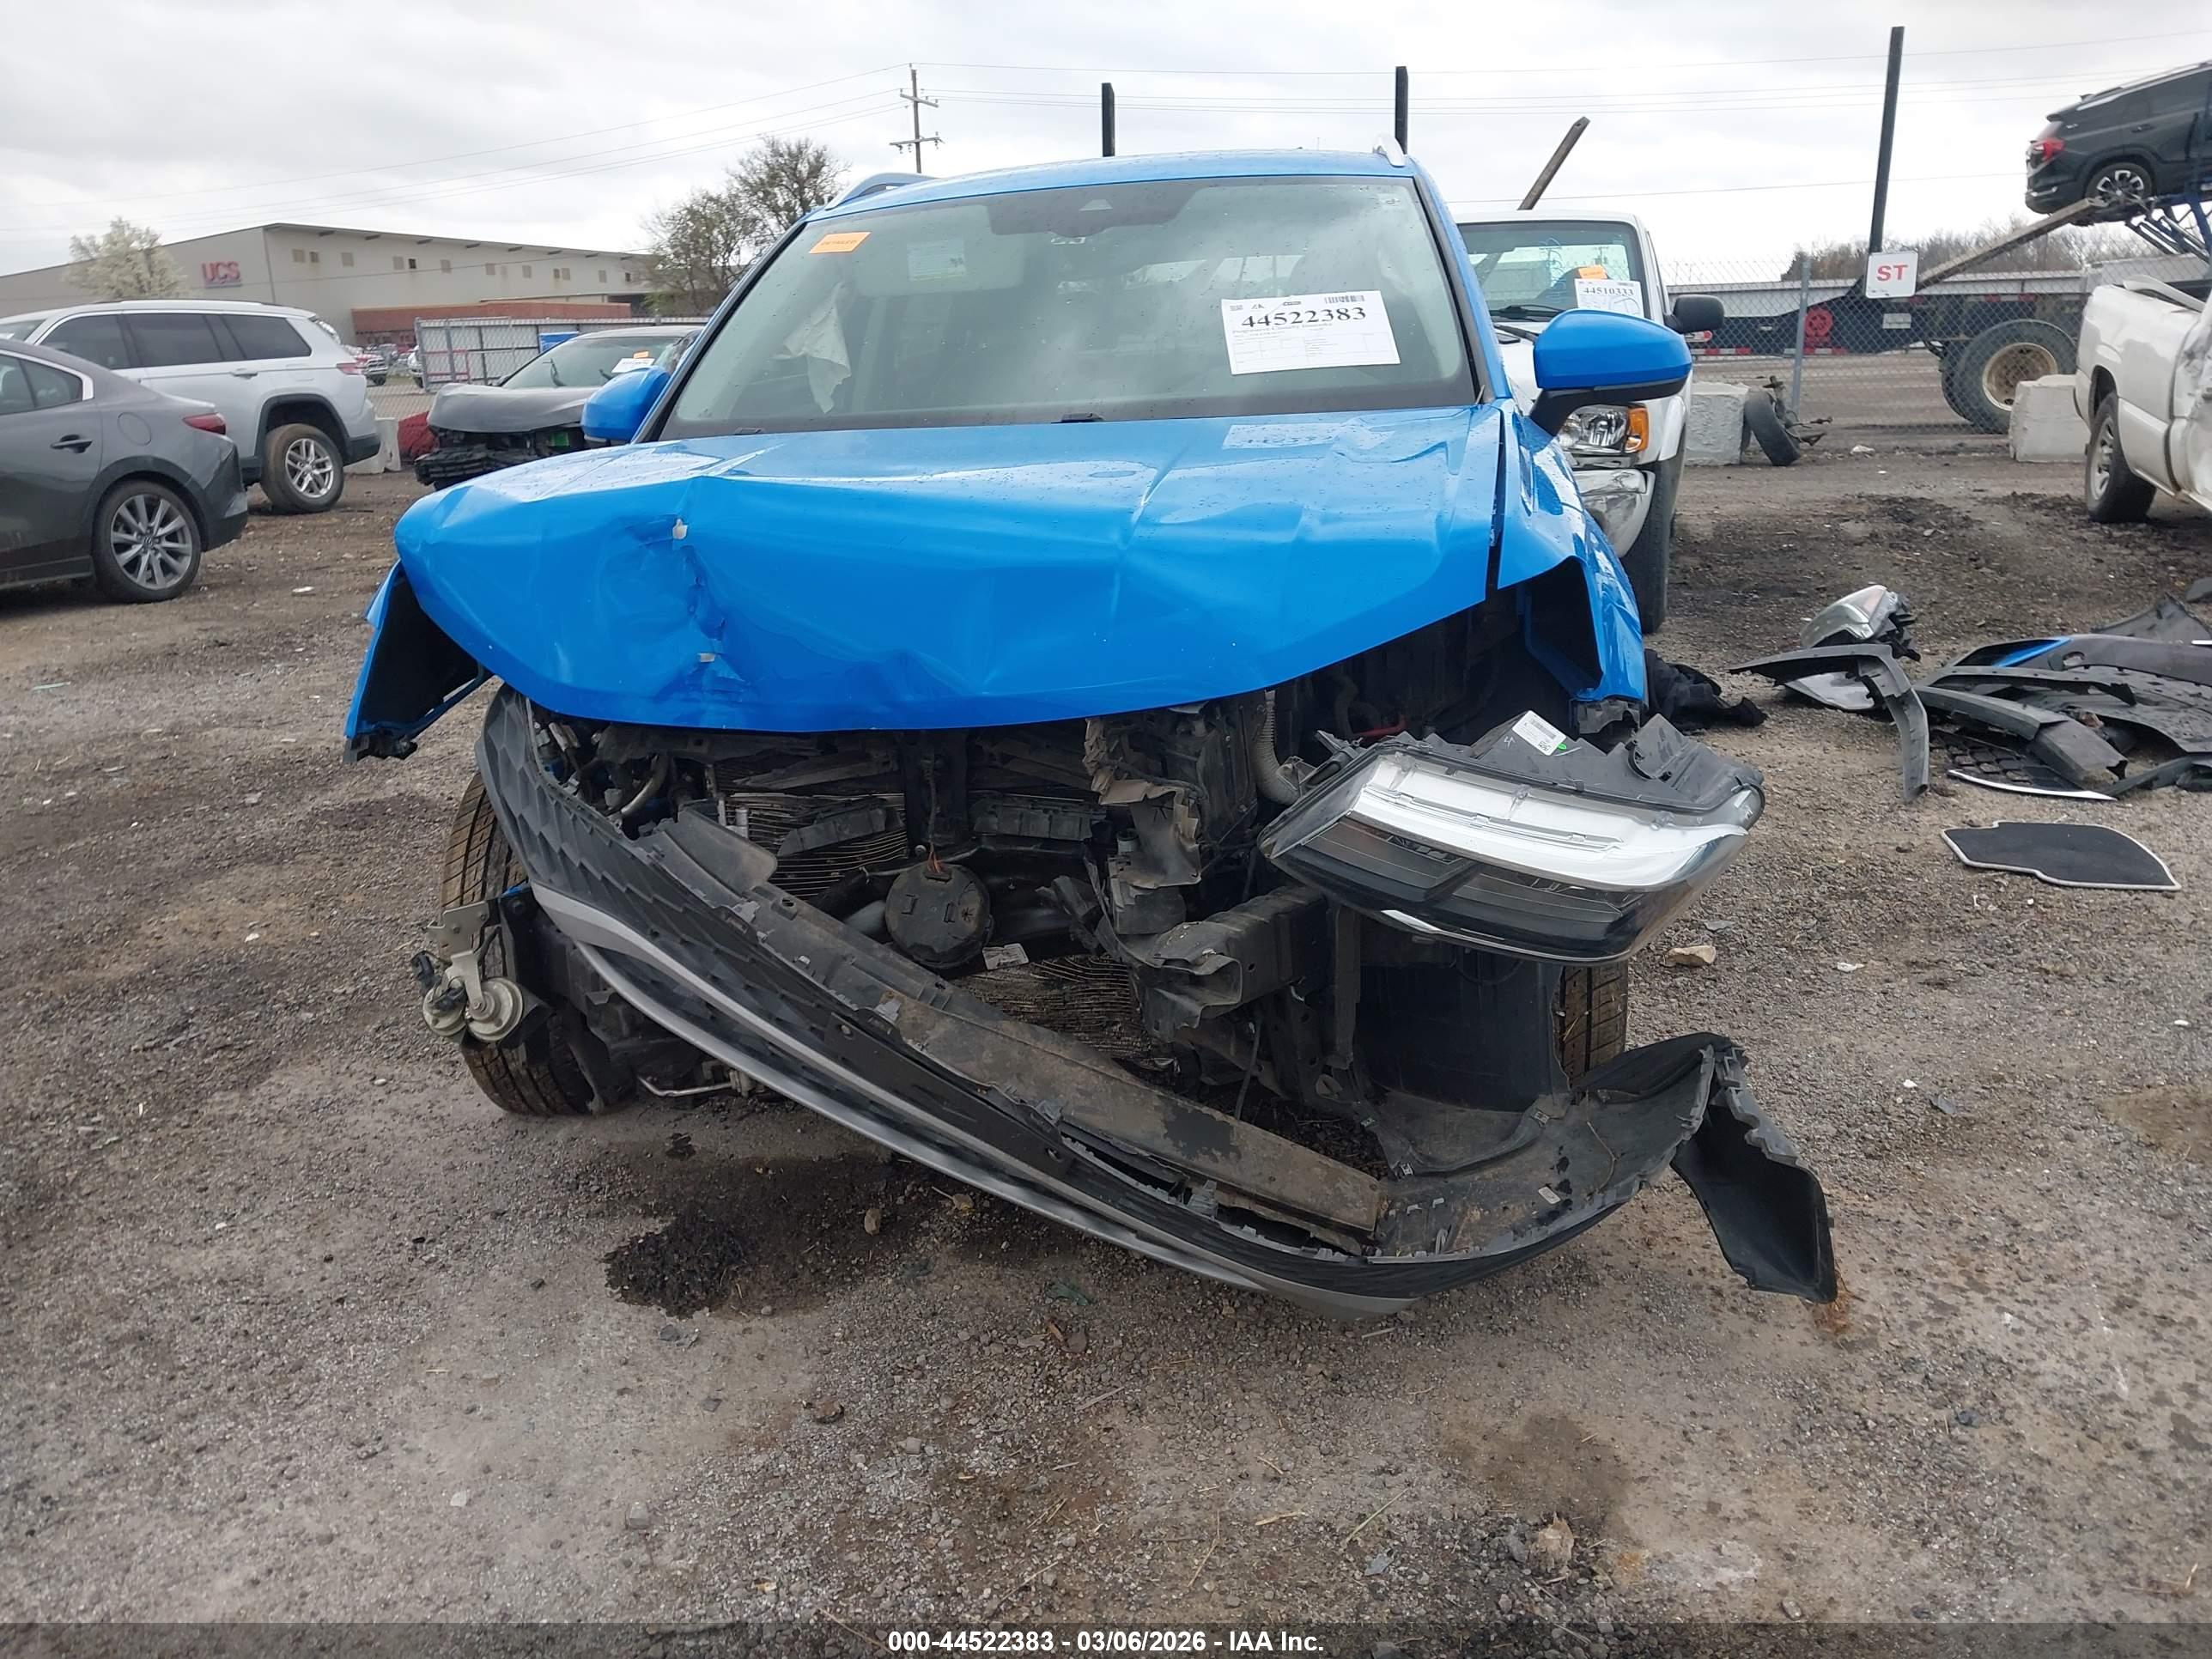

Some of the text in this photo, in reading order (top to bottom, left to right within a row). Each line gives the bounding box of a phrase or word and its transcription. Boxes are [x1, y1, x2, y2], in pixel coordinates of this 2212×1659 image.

[201, 261, 241, 283] UCS
[1877, 264, 1908, 282] ST
[1583, 287, 1634, 297] 44510333
[1241, 307, 1366, 328] 44522383
